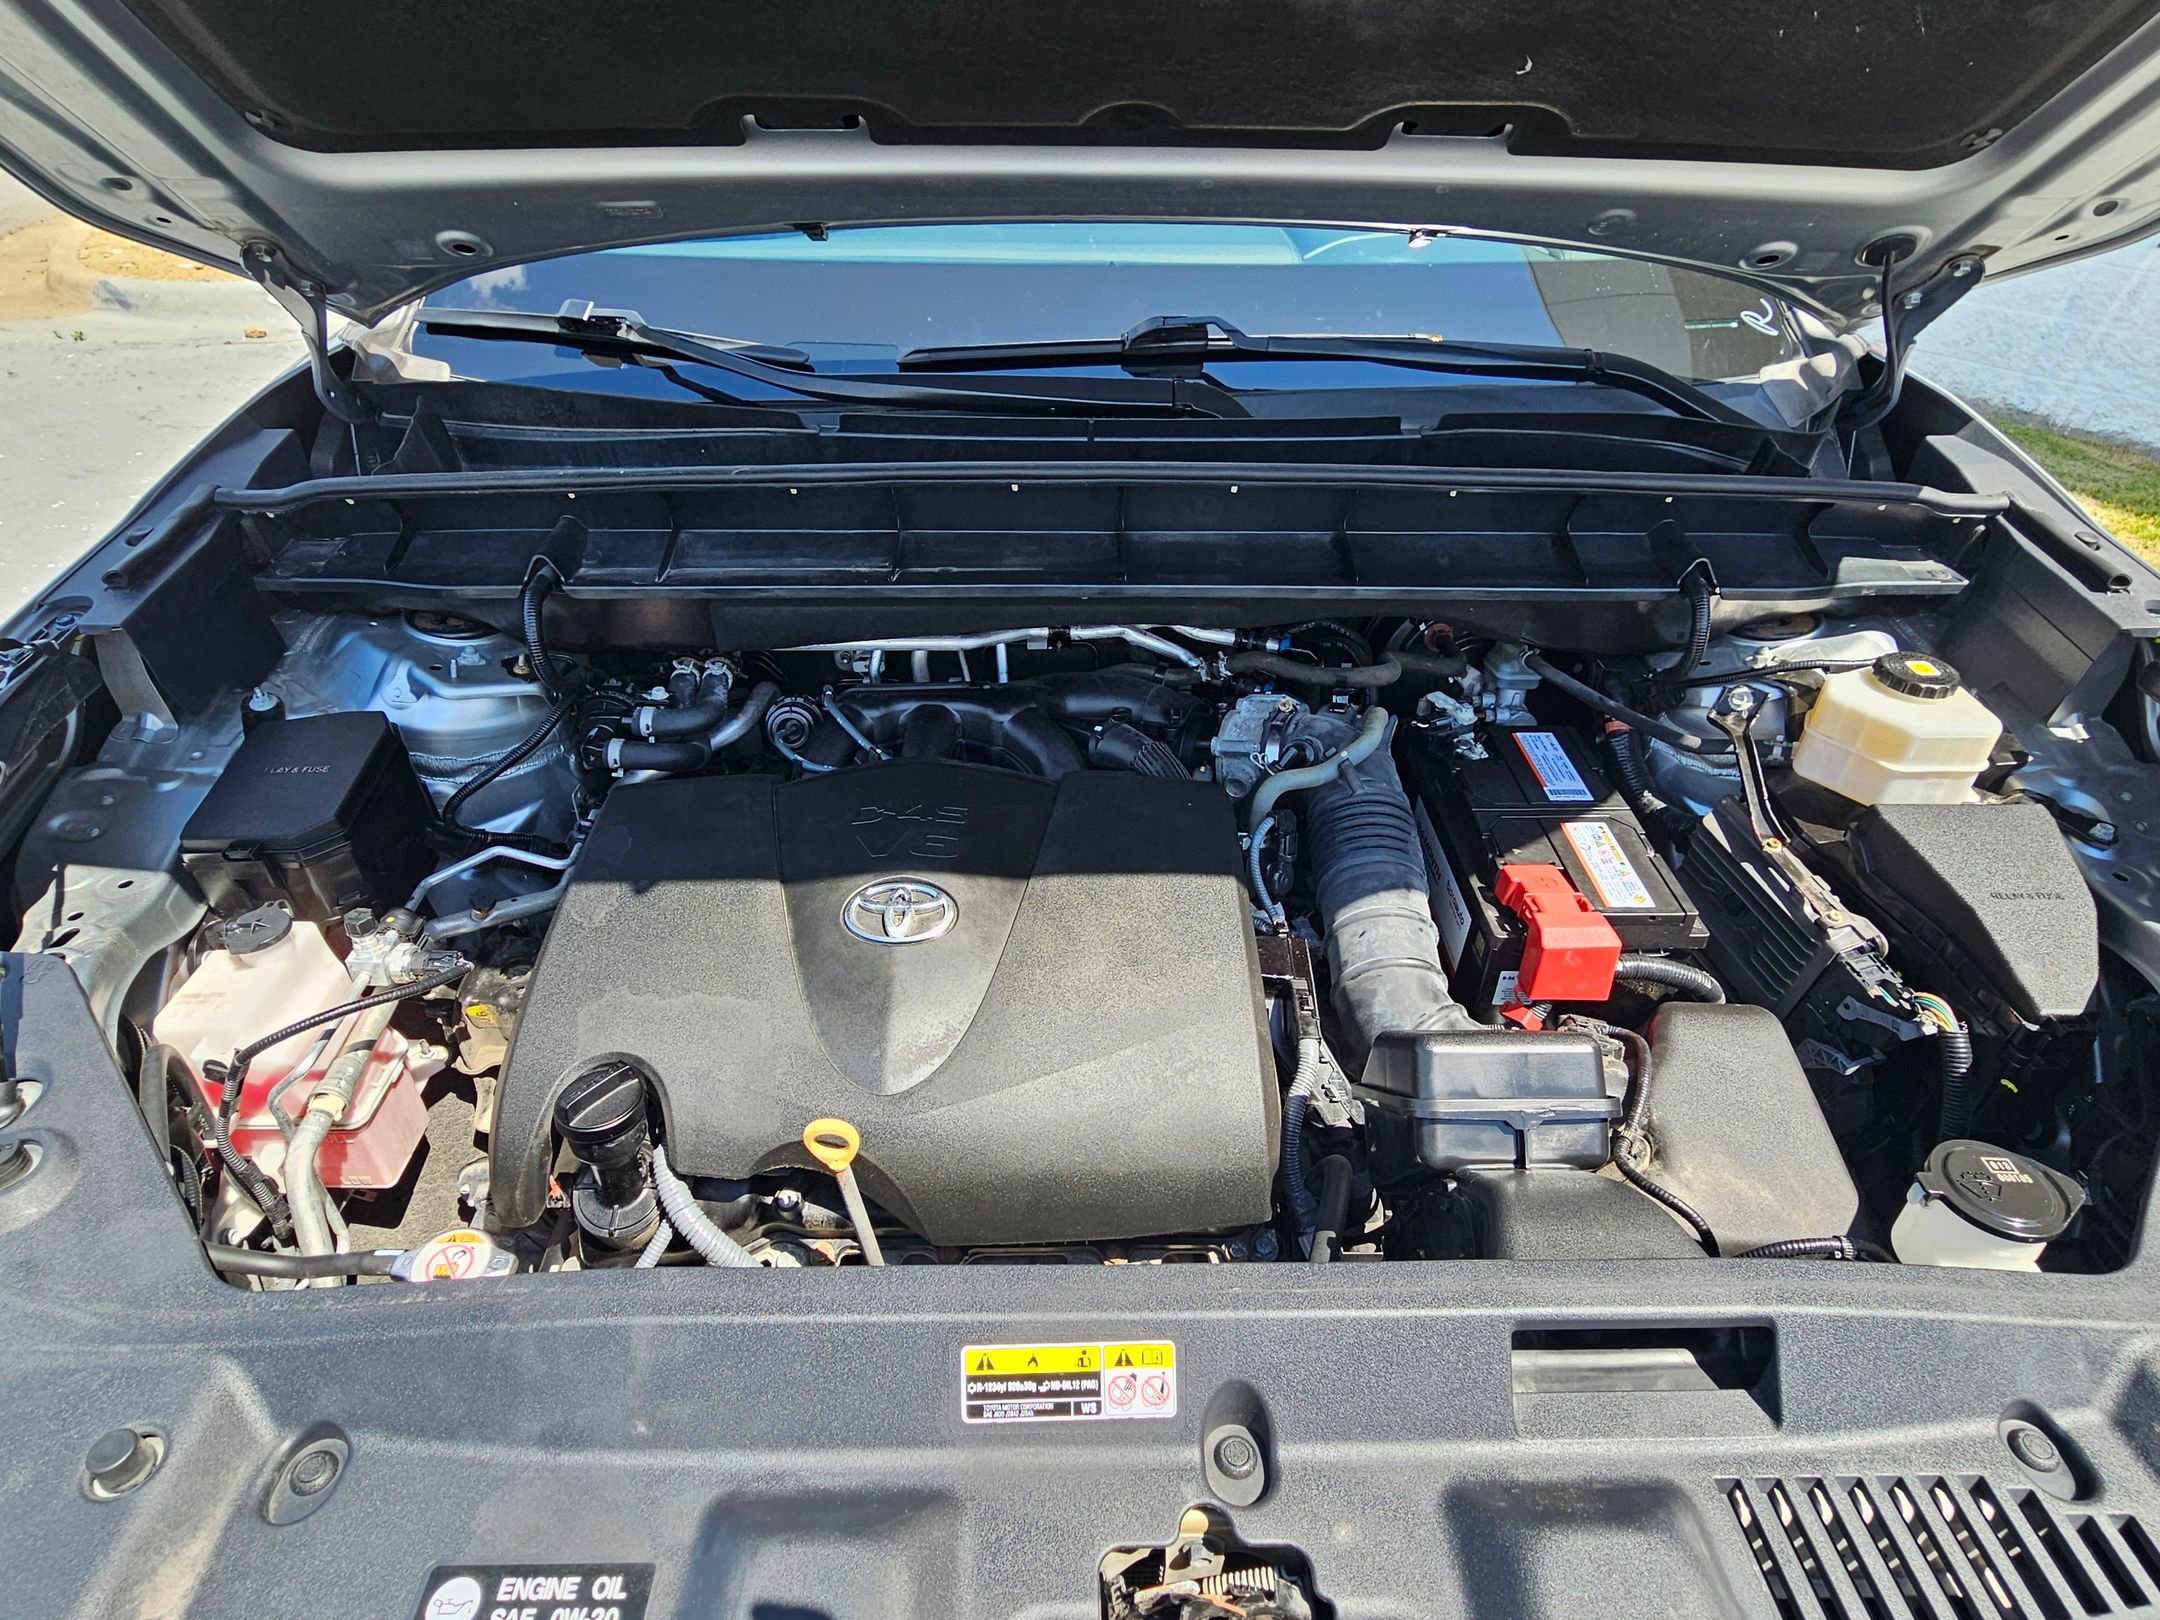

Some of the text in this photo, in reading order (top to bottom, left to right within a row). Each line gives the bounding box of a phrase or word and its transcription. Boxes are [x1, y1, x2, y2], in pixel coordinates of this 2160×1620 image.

[301, 765, 331, 774] FUSE
[855, 831, 960, 858] V6
[1081, 1401, 1098, 1415] WS
[496, 1575, 628, 1601] ENGINE OIL
